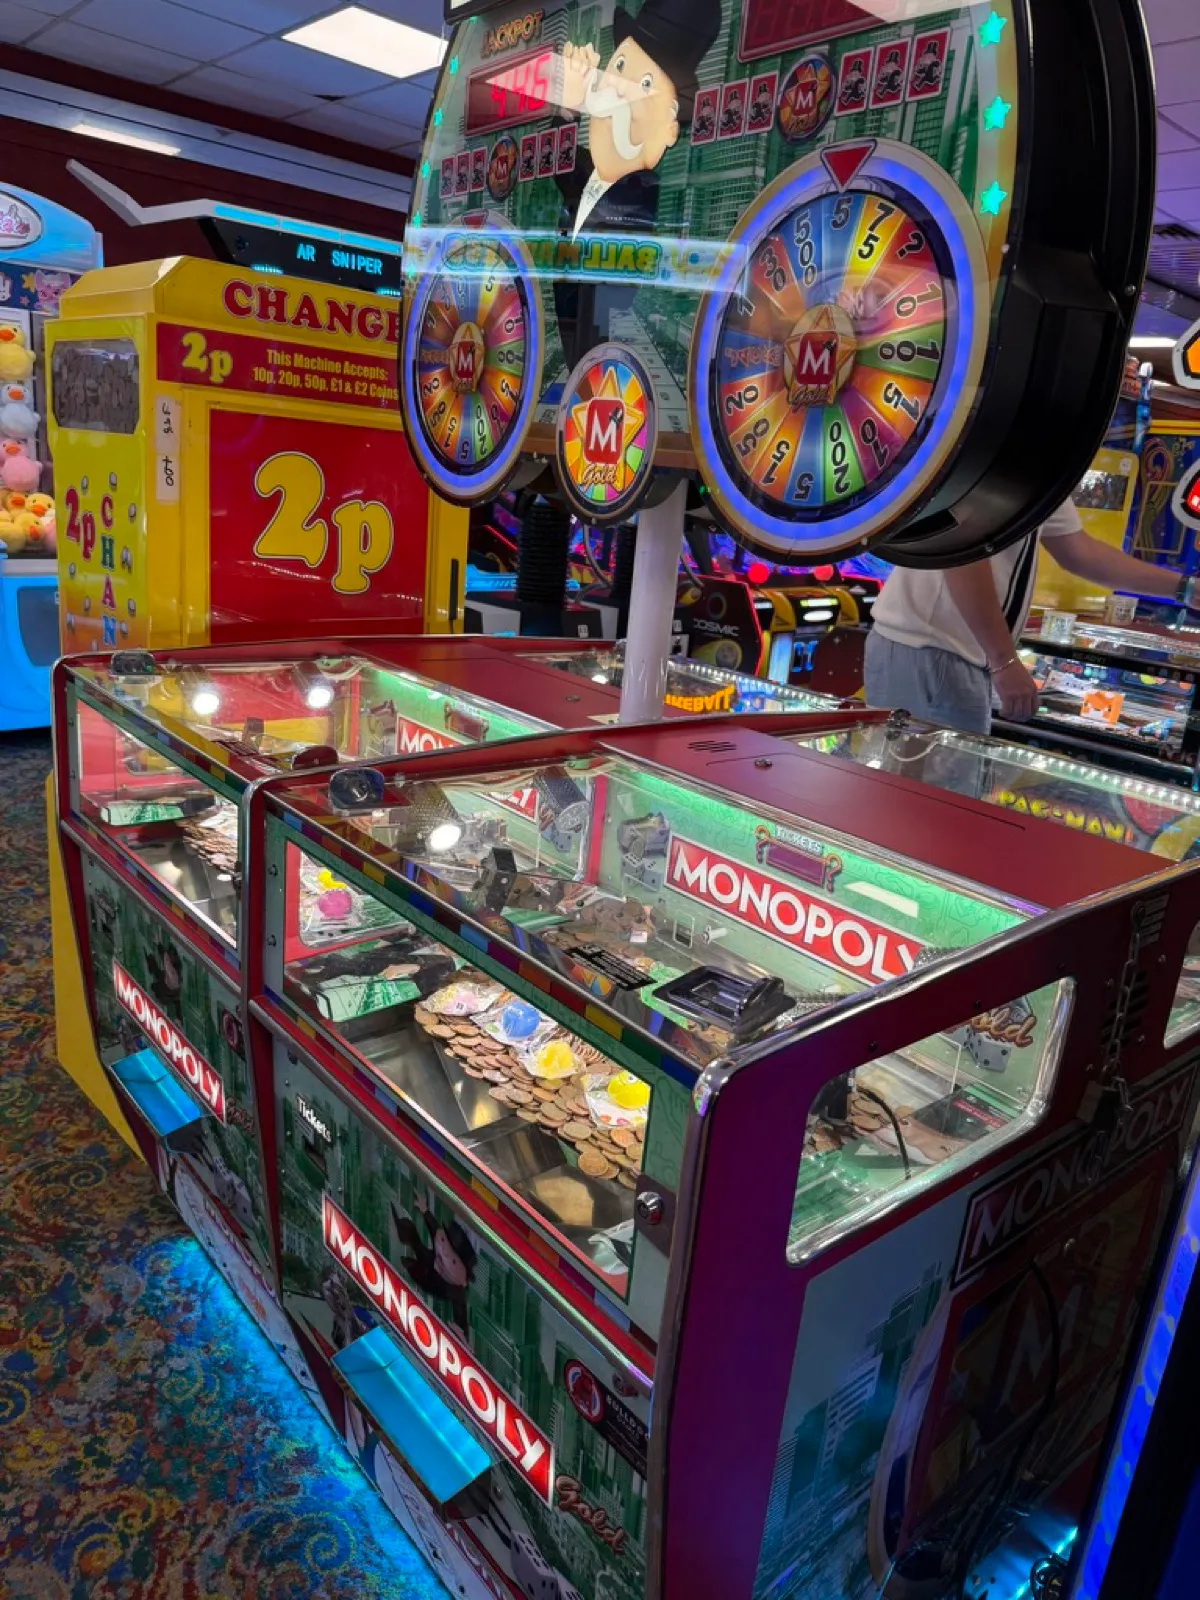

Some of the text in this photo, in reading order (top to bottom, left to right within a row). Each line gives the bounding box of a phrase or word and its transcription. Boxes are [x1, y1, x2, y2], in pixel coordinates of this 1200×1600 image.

[482, 12, 543, 57] JACKPOT
[832, 197, 852, 229] 5
[297, 244, 382, 275] AR SNIPER
[181, 331, 233, 384] 2p
[266, 349, 389, 382] This Machine Accepts:
[457, 350, 474, 372] M
[801, 342, 829, 375] M
[330, 378, 342, 392] £1
[345, 381, 353, 393] &
[354, 380, 368, 396] £2
[370, 383, 398, 401] Coins
[589, 411, 617, 452] M
[582, 463, 616, 491] Gold
[795, 472, 814, 500] 5
[65, 486, 96, 562] 2p
[253, 451, 394, 594] 2p
[117, 974, 221, 1106] MONOPOLY
[297, 1096, 331, 1142] Tickets
[330, 1214, 546, 1472] MONOPOLY
